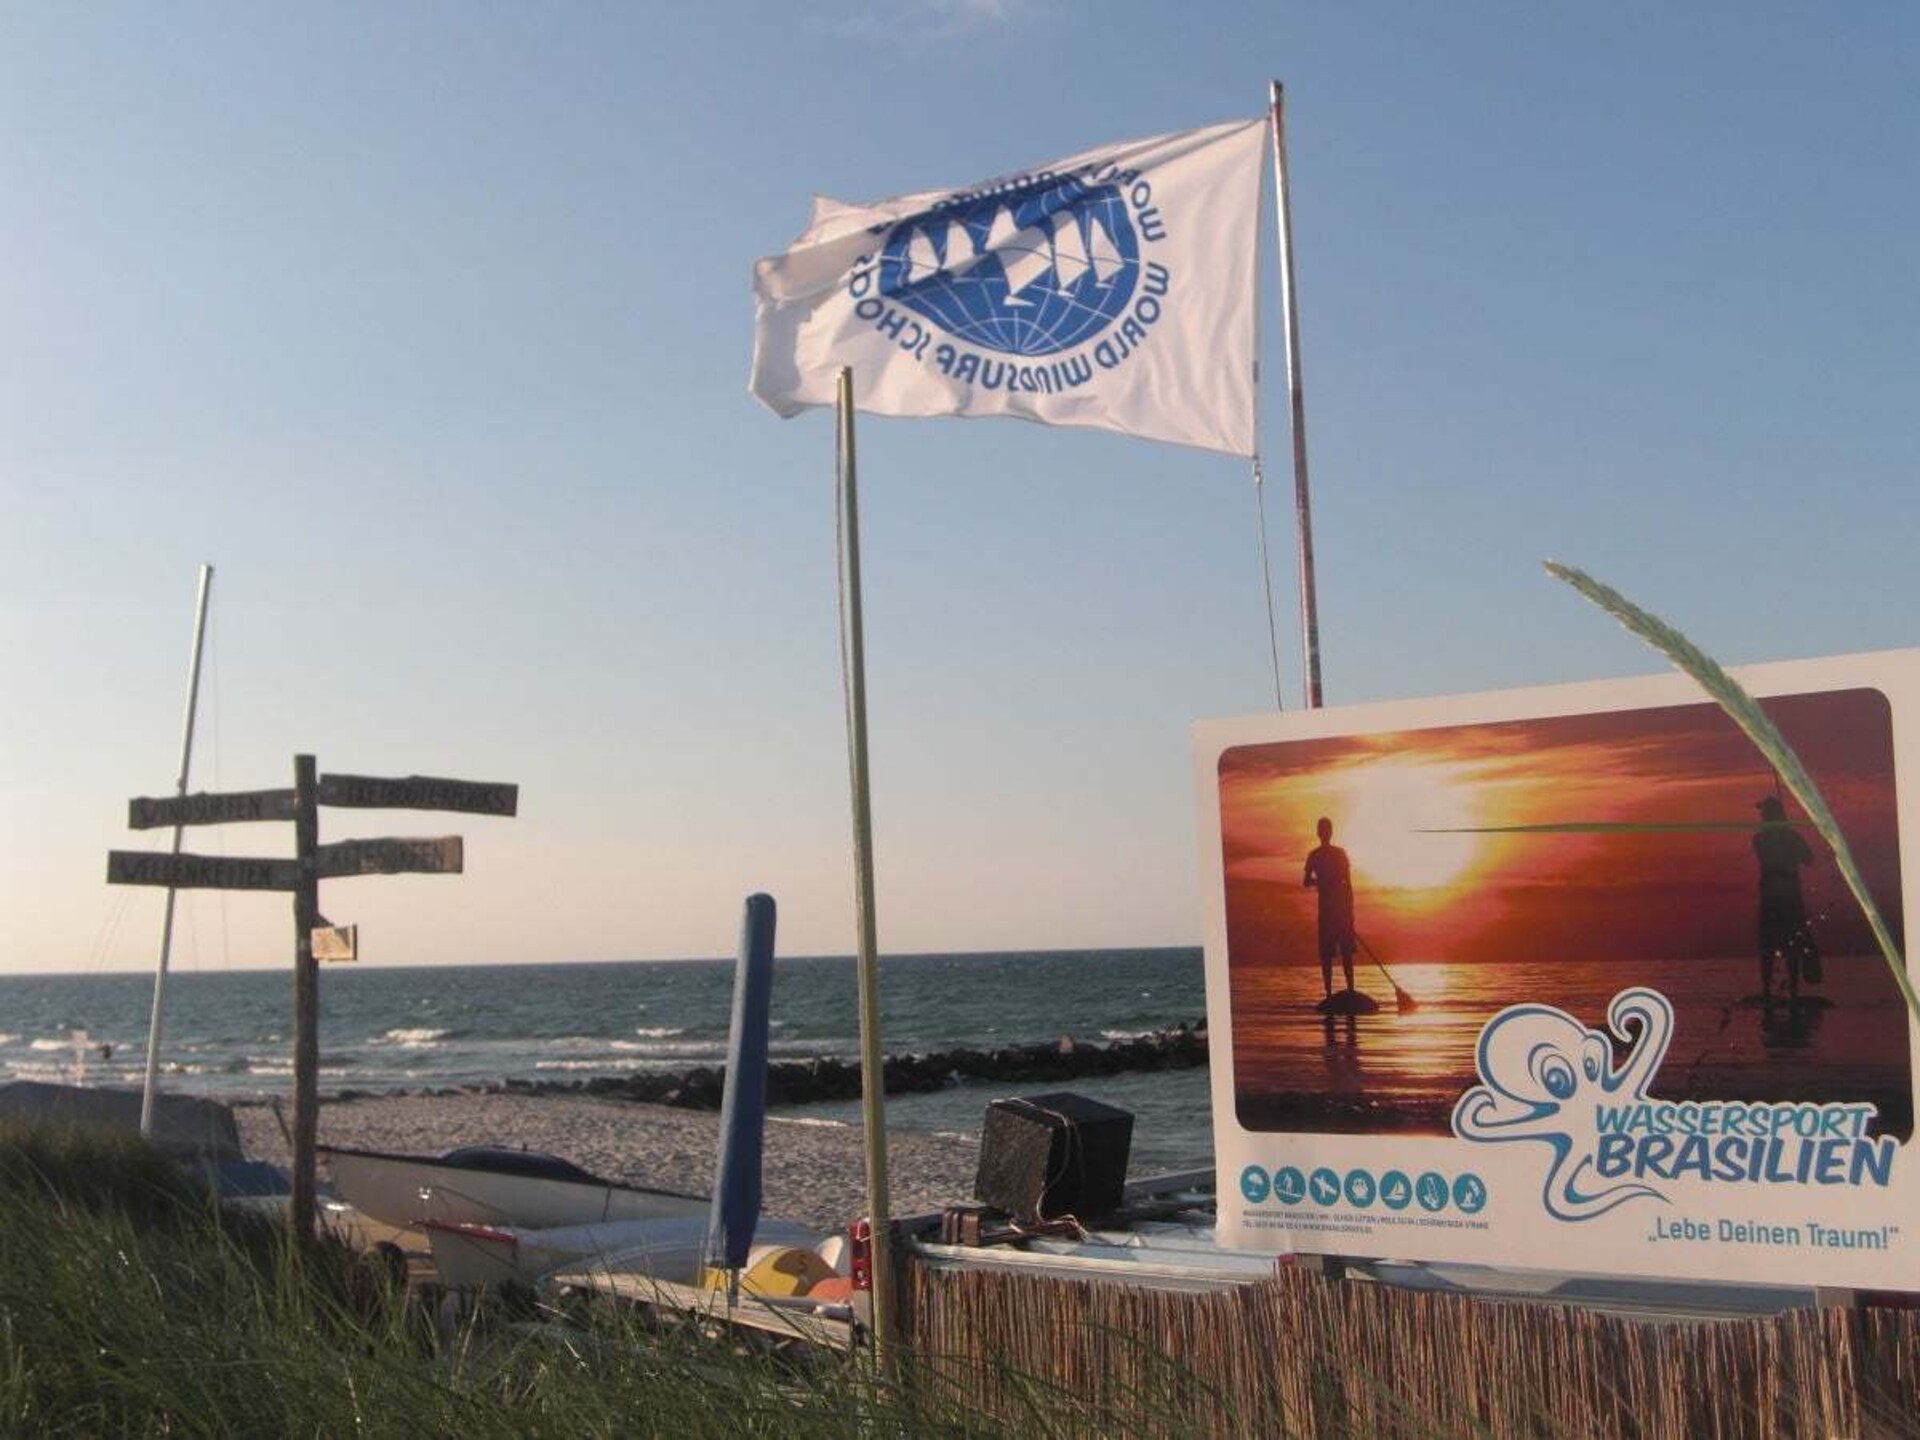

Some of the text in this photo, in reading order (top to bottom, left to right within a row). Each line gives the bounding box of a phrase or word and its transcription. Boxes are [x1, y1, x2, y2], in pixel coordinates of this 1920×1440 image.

[1596, 1104, 1873, 1138] WASSERSPORT
[1596, 1133, 1895, 1187] BRASILIEN
[1718, 1219, 1800, 1246] Deinen
